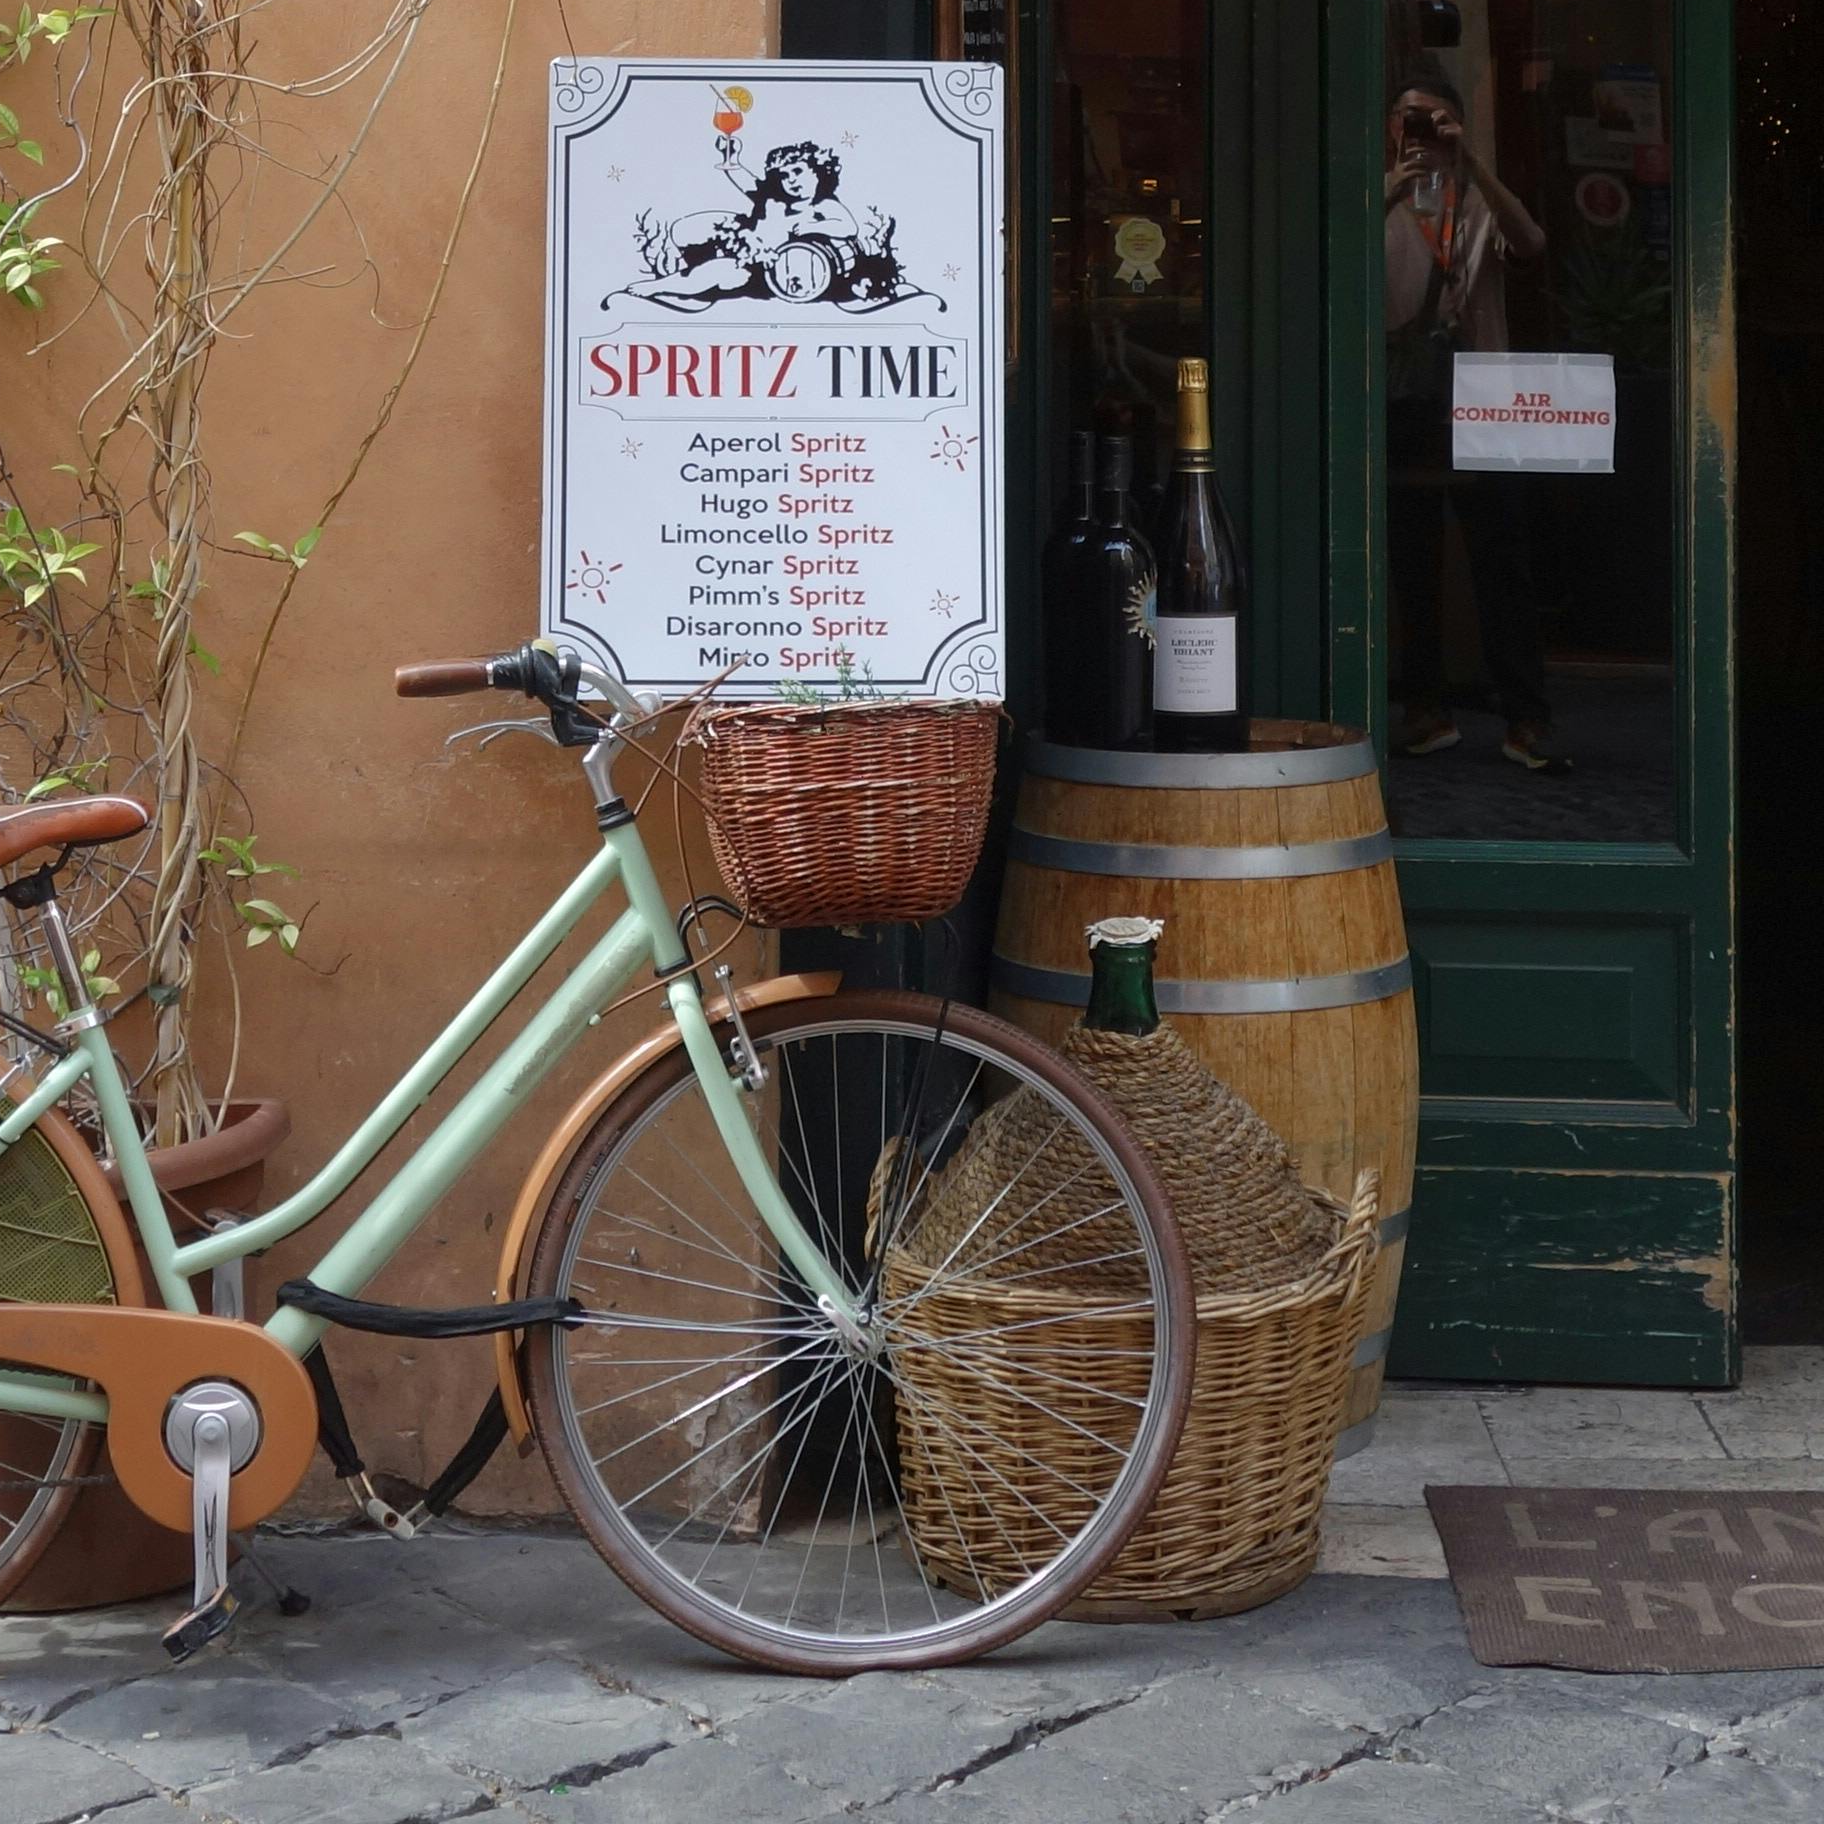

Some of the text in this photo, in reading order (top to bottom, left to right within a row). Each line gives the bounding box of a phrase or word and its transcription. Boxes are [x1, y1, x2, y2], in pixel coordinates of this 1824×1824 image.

[590, 344, 958, 399] SPRITZ TIME
[1512, 392, 1552, 407] AIR
[1454, 407, 1610, 425] CONDITIONING
[688, 433, 866, 458] Aperol Spritz
[680, 463, 874, 488] Campari Spritz
[701, 494, 853, 519] Hugo Spritz
[661, 524, 893, 549] Limoncello Spritz
[695, 555, 859, 580] Cynar Spritz
[689, 585, 865, 611] Pimm's Spritz
[667, 616, 888, 641] Disaronno Spritz
[699, 647, 856, 672] Mirto Spritz
